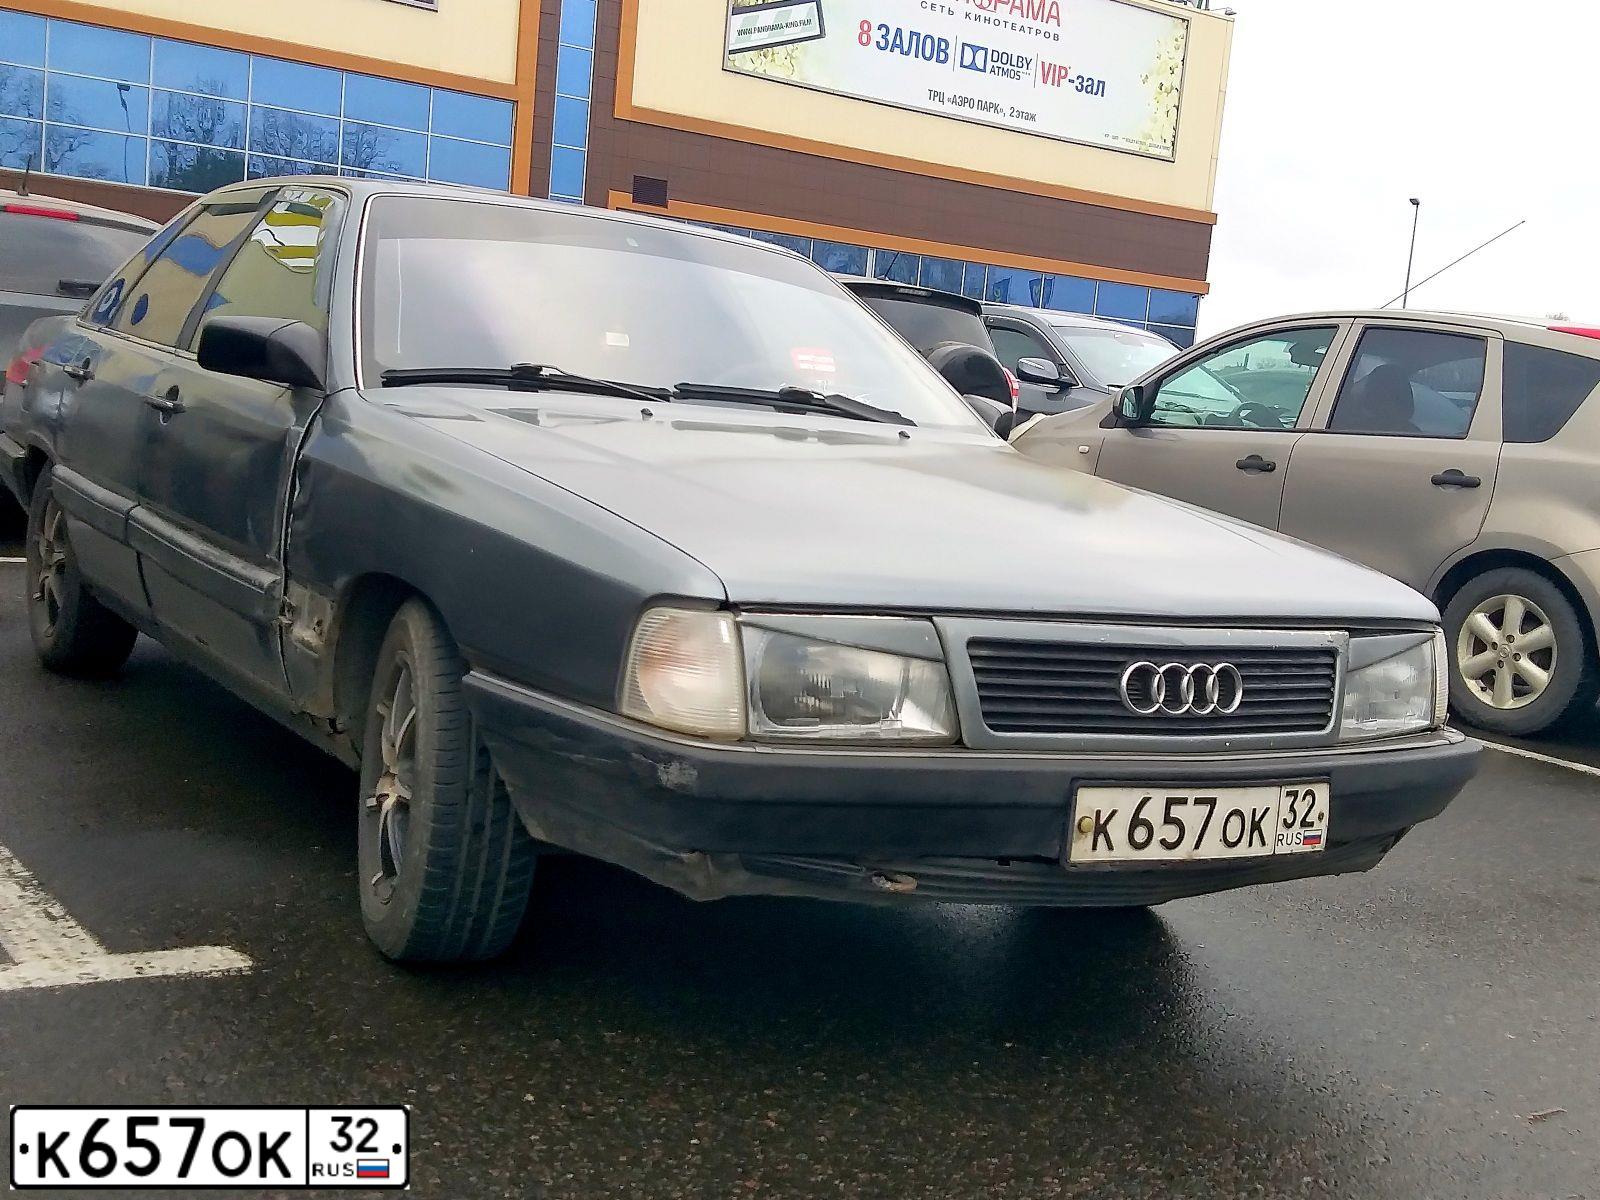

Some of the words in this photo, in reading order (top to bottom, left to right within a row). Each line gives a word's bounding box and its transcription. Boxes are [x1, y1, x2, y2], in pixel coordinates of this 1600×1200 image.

[920, 1, 955, 16] СЕТЬ
[964, 11, 1060, 42] КИНОТЕАТРОВ
[858, 19, 872, 46] 8
[876, 23, 950, 64] ЗАЛОВ
[990, 49, 1032, 70] DOLBY
[989, 64, 1021, 81] ATMOS
[928, 89, 945, 105] ТРЦ
[947, 94, 975, 109] «АЭРО
[1282, 788, 1316, 829] 32
[1277, 832, 1302, 847] RUS
